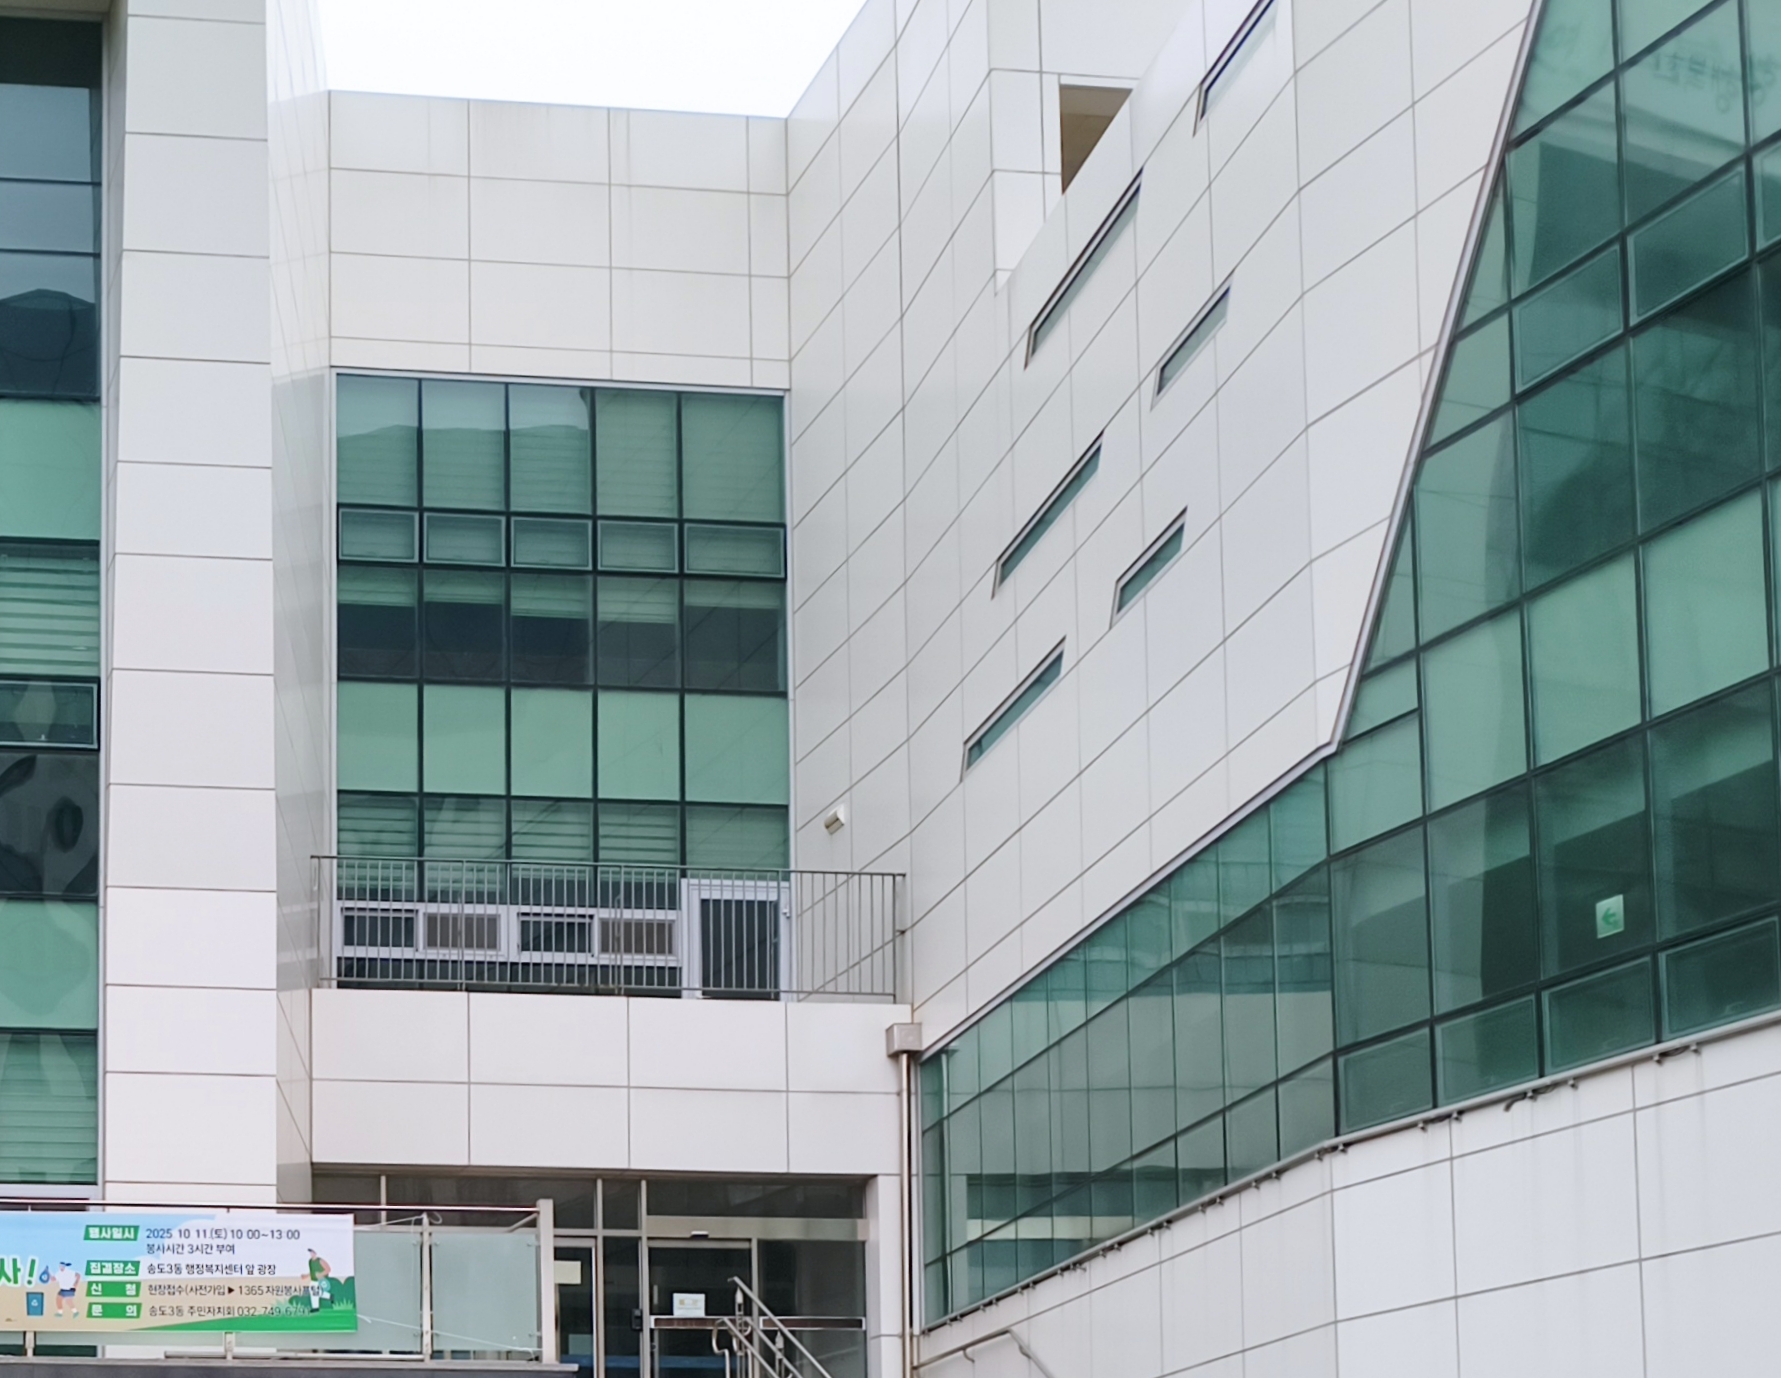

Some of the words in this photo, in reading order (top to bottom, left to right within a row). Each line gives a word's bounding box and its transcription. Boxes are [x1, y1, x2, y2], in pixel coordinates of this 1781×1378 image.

[88, 1227, 135, 1239] 행사일시
[230, 1229, 300, 1240] 1000~1300
[146, 1243, 184, 1254] 봉사시간
[187, 1243, 214, 1255] 3시간
[90, 1262, 136, 1274] 집결장소
[147, 1263, 182, 1275] 송도3동
[185, 1263, 243, 1276] 행정복지센터
[245, 1264, 255, 1275] 앞
[257, 1264, 276, 1275] 광장
[239, 1285, 264, 1296] 1365
[149, 1305, 184, 1317] 송도3동
[187, 1306, 235, 1317] 주민자치회
[237, 1306, 311, 1317] 032-7496791
